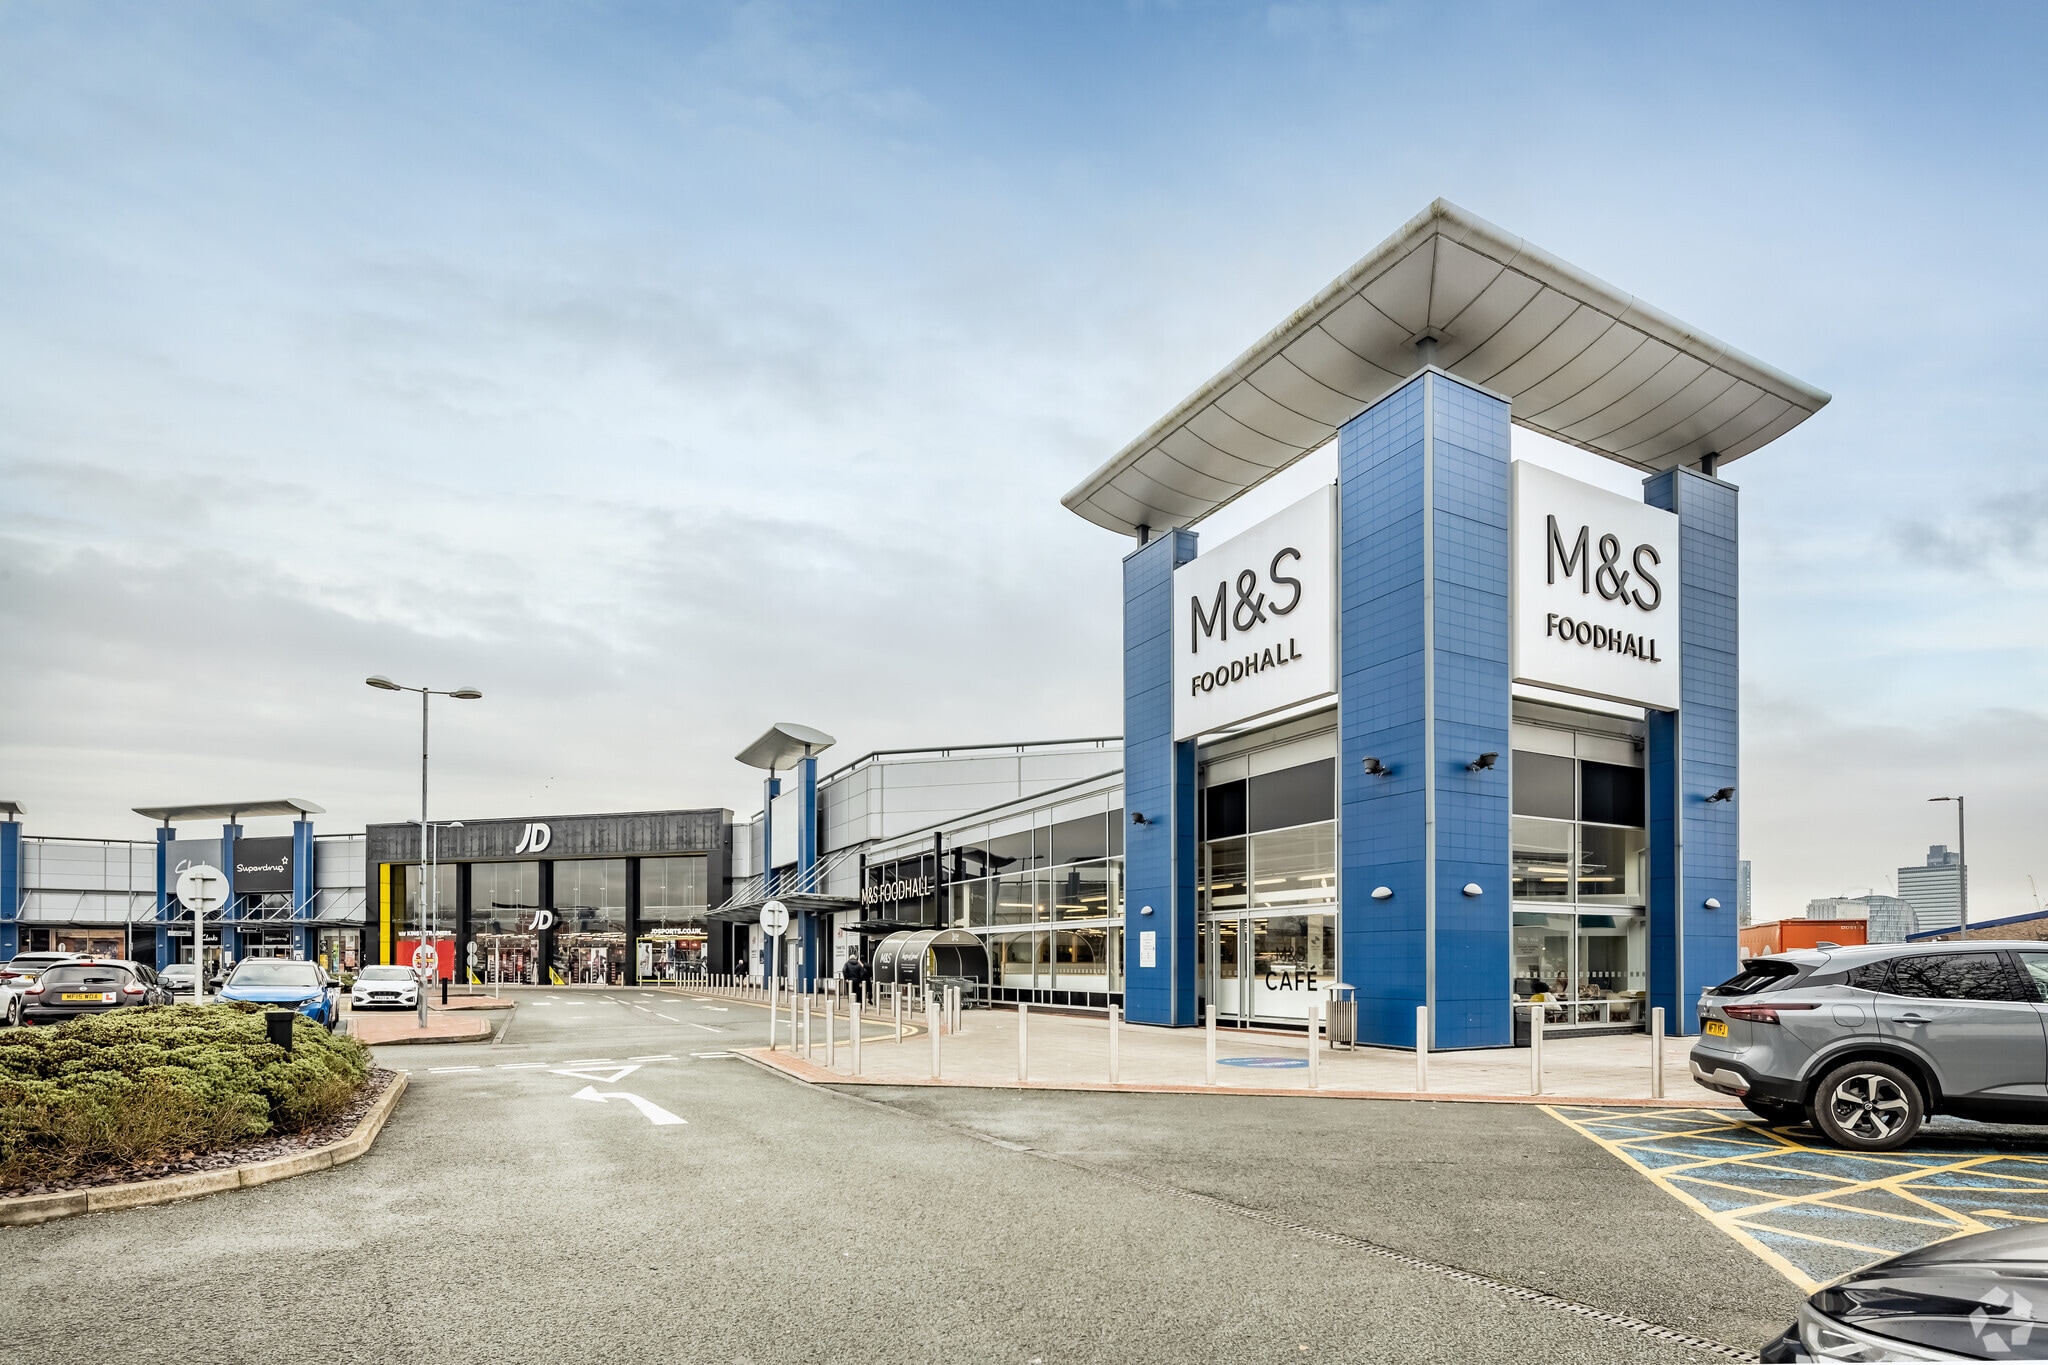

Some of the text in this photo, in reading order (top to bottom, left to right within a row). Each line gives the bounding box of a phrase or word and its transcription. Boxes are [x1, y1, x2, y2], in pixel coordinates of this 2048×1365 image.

[1547, 514, 1662, 612] M&S
[1190, 546, 1302, 655] M&S
[1546, 612, 1662, 663] FOODHALL
[1190, 638, 1302, 697] FOODHALL
[515, 823, 551, 854] JD
[236, 863, 285, 874] Superdrug
[861, 876, 931, 906] M&S FOODHALL
[528, 910, 553, 931] JD
[1265, 964, 1318, 991] CAFÉ
